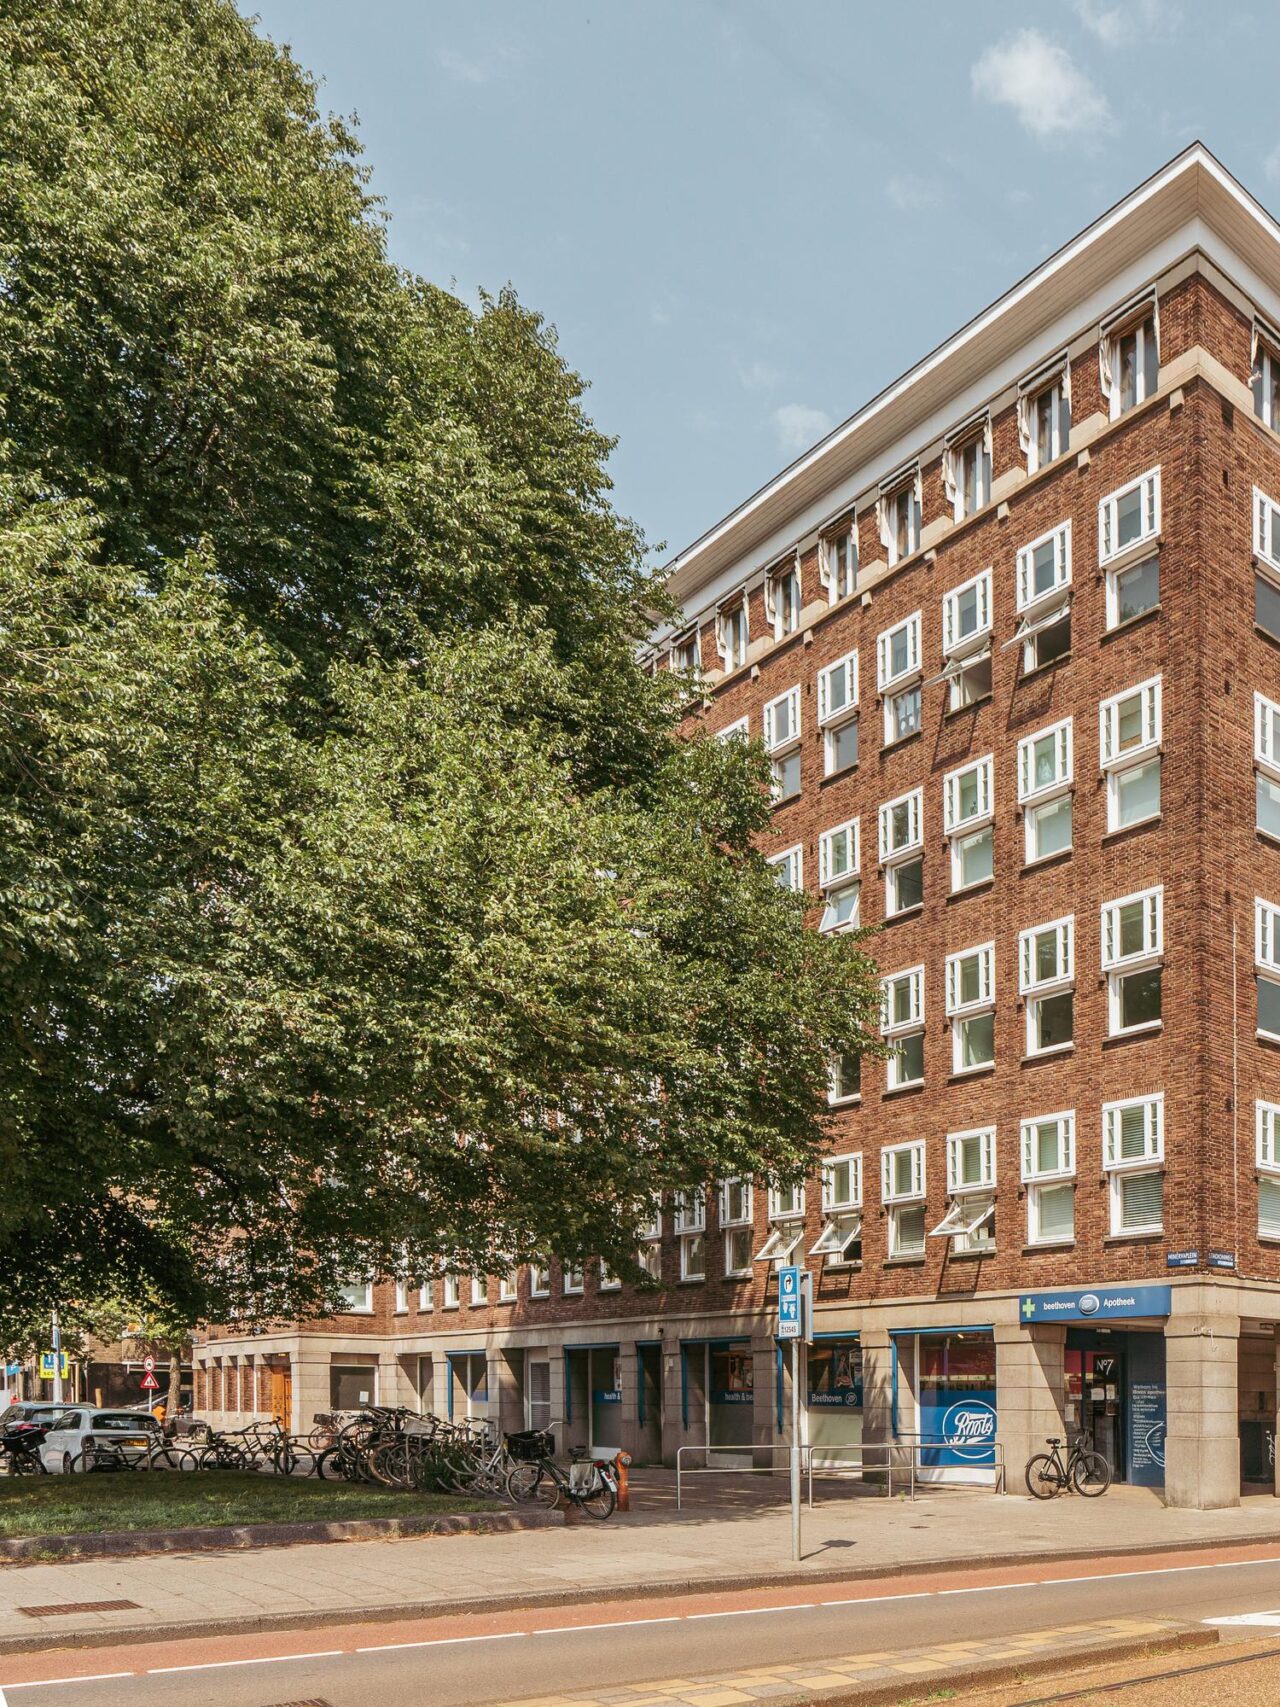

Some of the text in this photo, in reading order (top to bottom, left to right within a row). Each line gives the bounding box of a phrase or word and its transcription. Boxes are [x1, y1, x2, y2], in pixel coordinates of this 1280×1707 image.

[1043, 1301, 1075, 1311] beethoven
[1103, 1297, 1136, 1308] Apotheek
[811, 1393, 843, 1403] Beethoven
